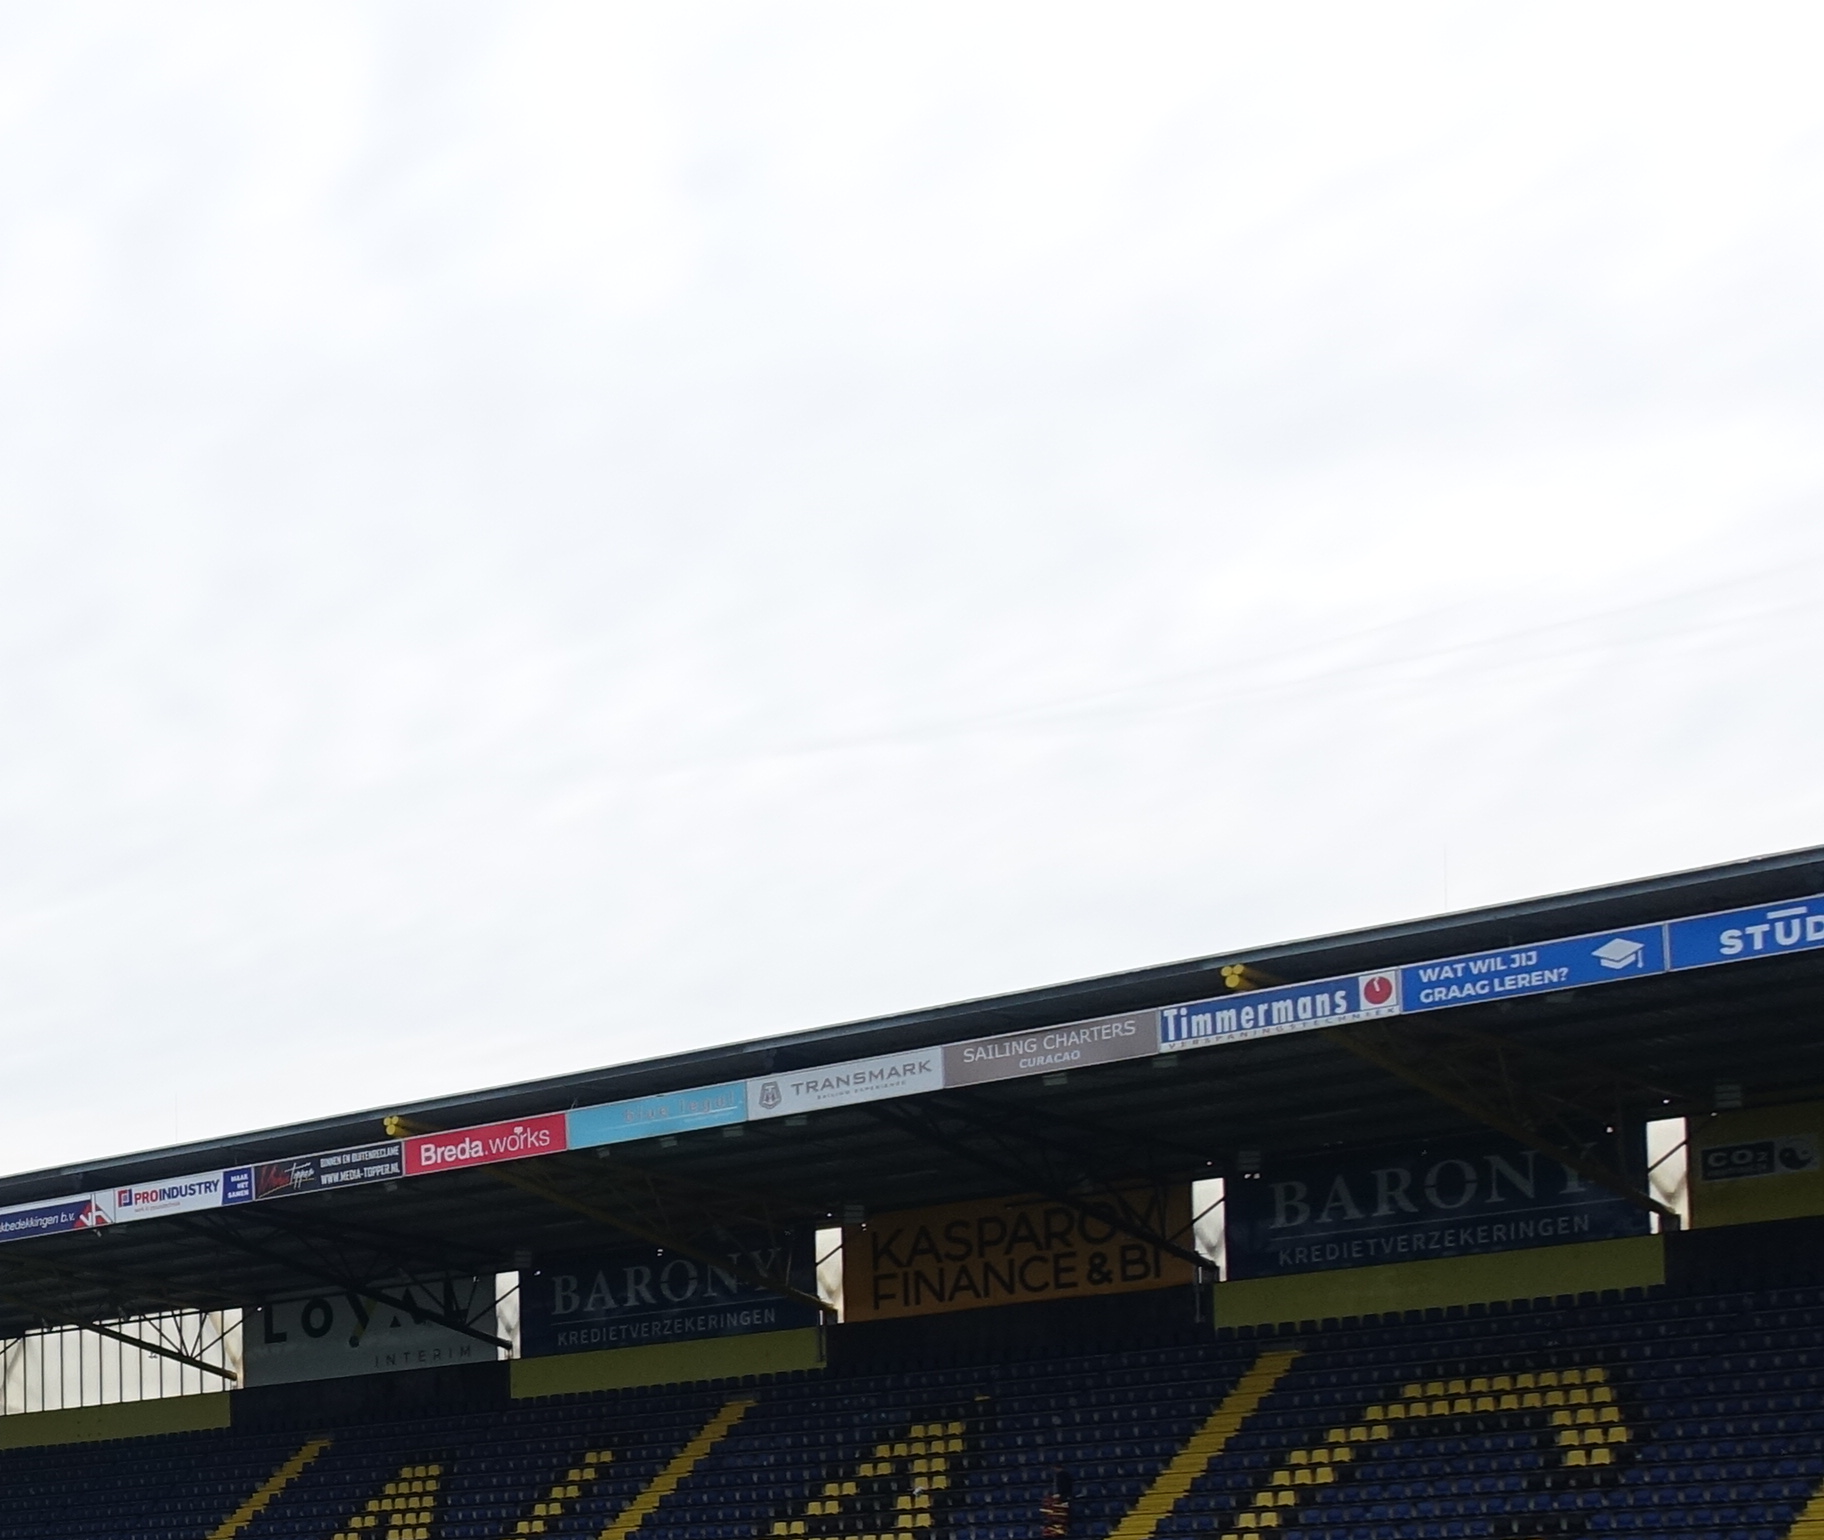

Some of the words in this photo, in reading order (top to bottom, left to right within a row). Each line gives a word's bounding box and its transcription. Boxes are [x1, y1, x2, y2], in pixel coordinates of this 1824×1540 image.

[1720, 907, 1824, 955] STUD
[1419, 960, 1467, 983] WAT
[1468, 954, 1507, 975] WIL
[1509, 950, 1538, 970] JIJ
[1419, 980, 1489, 1004] GRAAG
[1493, 966, 1568, 993] LEREN?
[1163, 990, 1347, 1043] Timmermans
[963, 1037, 1037, 1064] SAILING
[1043, 1020, 1136, 1050] CHARTERS
[1019, 1050, 1081, 1068] CURACAO
[790, 1060, 932, 1097] TRANSMARK
[420, 1125, 551, 1167] Breda.works
[134, 1179, 220, 1205] PROINDUSTRY
[60, 1210, 76, 1224] b.v.
[1279, 1213, 1591, 1267] KREDIETVERZEKERINGEN
[551, 1248, 782, 1317] BARONY
[873, 1251, 1078, 1310] FINANCE
[1087, 1246, 1114, 1283] &
[1121, 1243, 1161, 1282] BI
[557, 1308, 776, 1347] KREDIETVERZEKERINGEN
[374, 1344, 472, 1367] INTERIM
